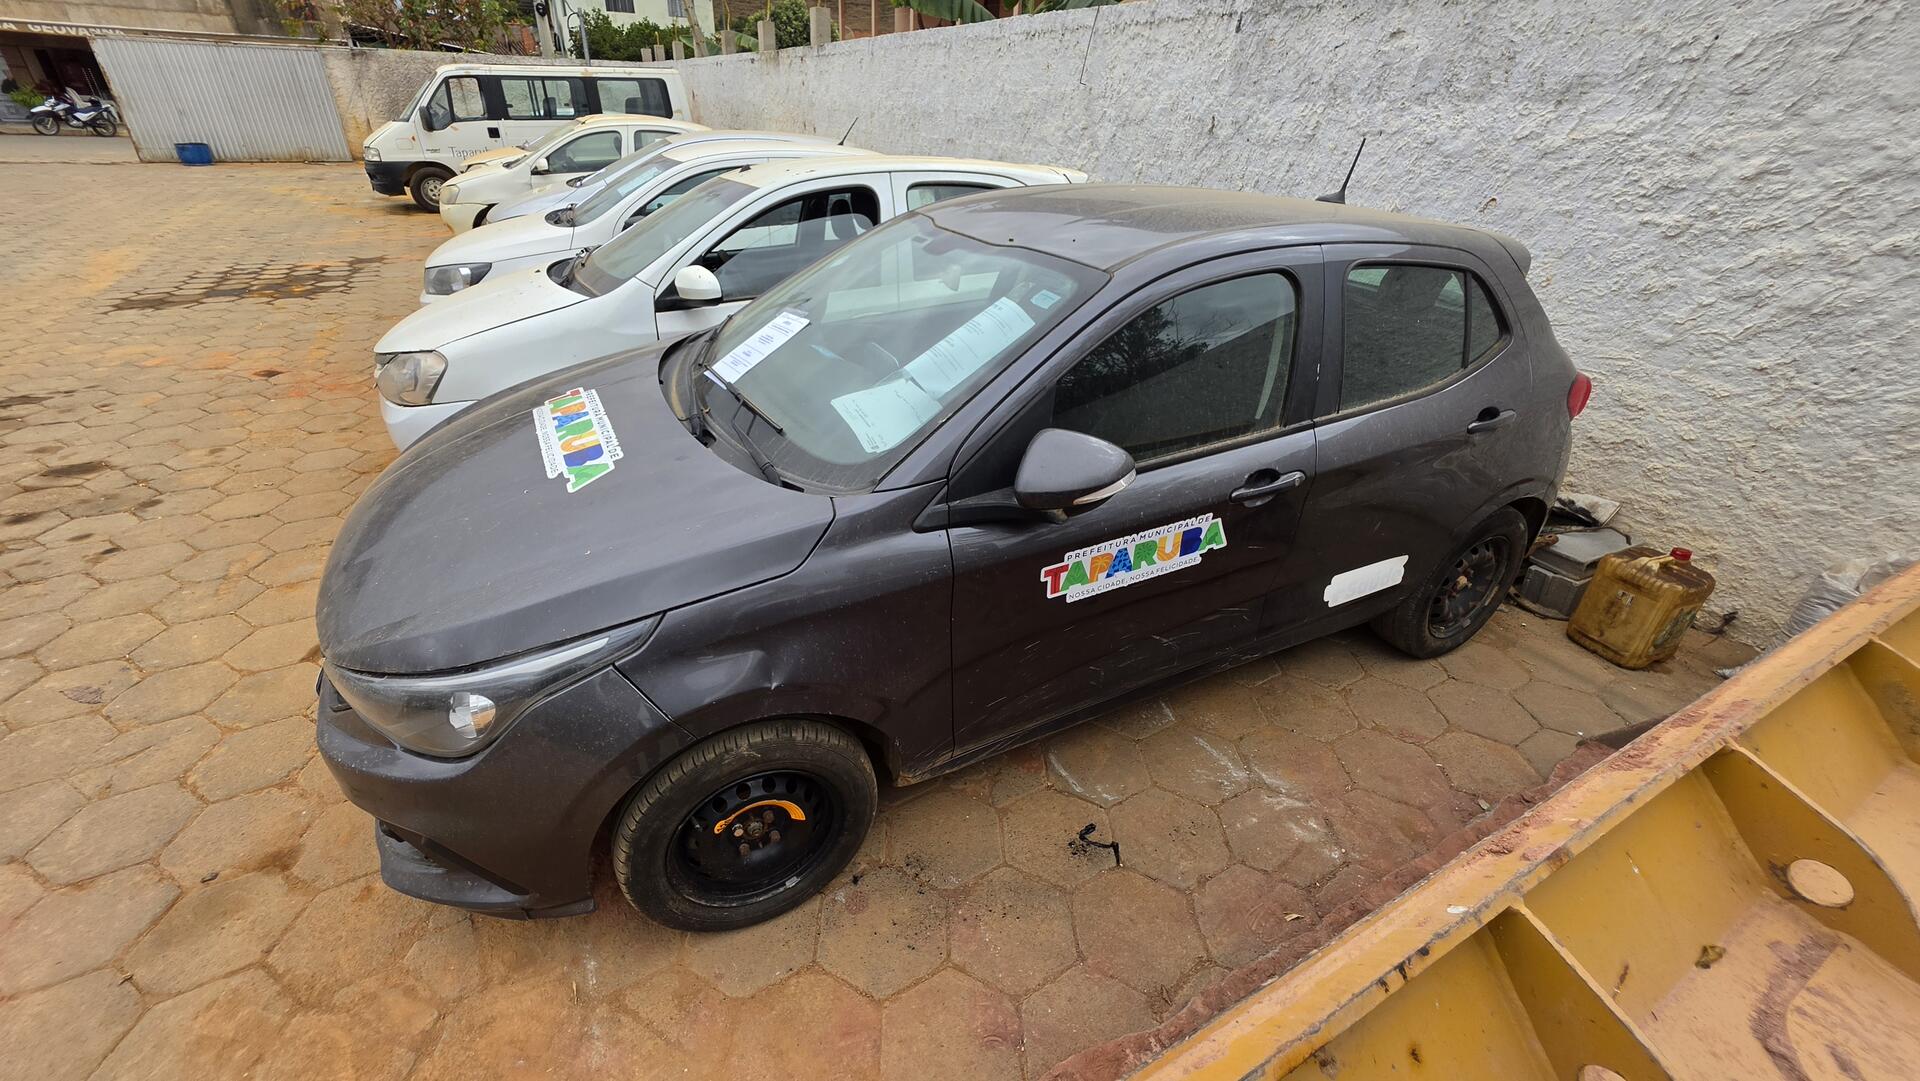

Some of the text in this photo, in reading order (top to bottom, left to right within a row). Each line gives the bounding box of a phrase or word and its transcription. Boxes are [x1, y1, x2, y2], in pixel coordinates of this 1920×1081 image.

[547, 389, 610, 490] TAPARUBA
[596, 415, 615, 448] MUNICIPAL
[607, 447, 619, 459] DE
[1044, 521, 1223, 595] TAPARUBA
[1067, 515, 1211, 561] PREFEITURA MUNICIPAL DE
[1068, 556, 1198, 600] NOSSA CIDADE, NOSSA FELICIDADE.
